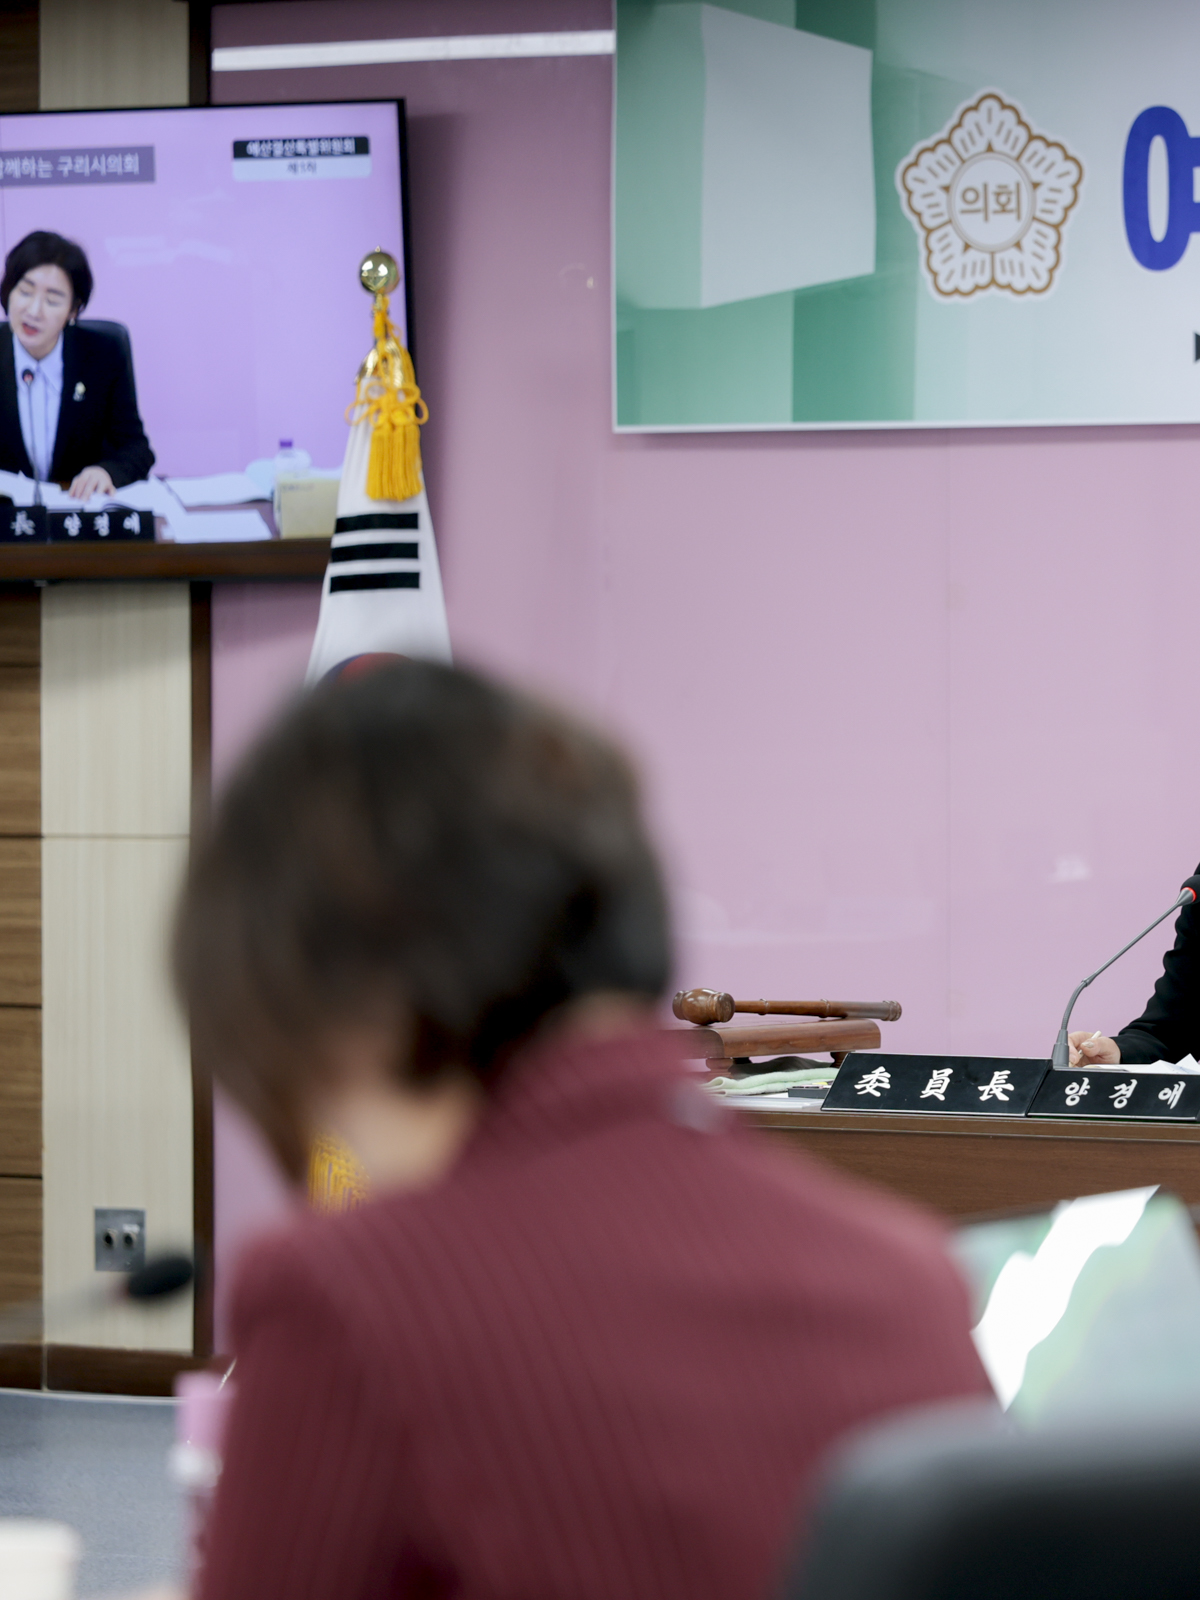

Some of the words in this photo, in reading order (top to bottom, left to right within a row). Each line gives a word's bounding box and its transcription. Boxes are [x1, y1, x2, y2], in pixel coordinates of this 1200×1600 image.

[57, 152, 140, 177] 구리시의회
[959, 181, 1023, 222] 의회
[854, 1066, 1015, 1102] 委員長
[1064, 1076, 1187, 1110] 양경애
